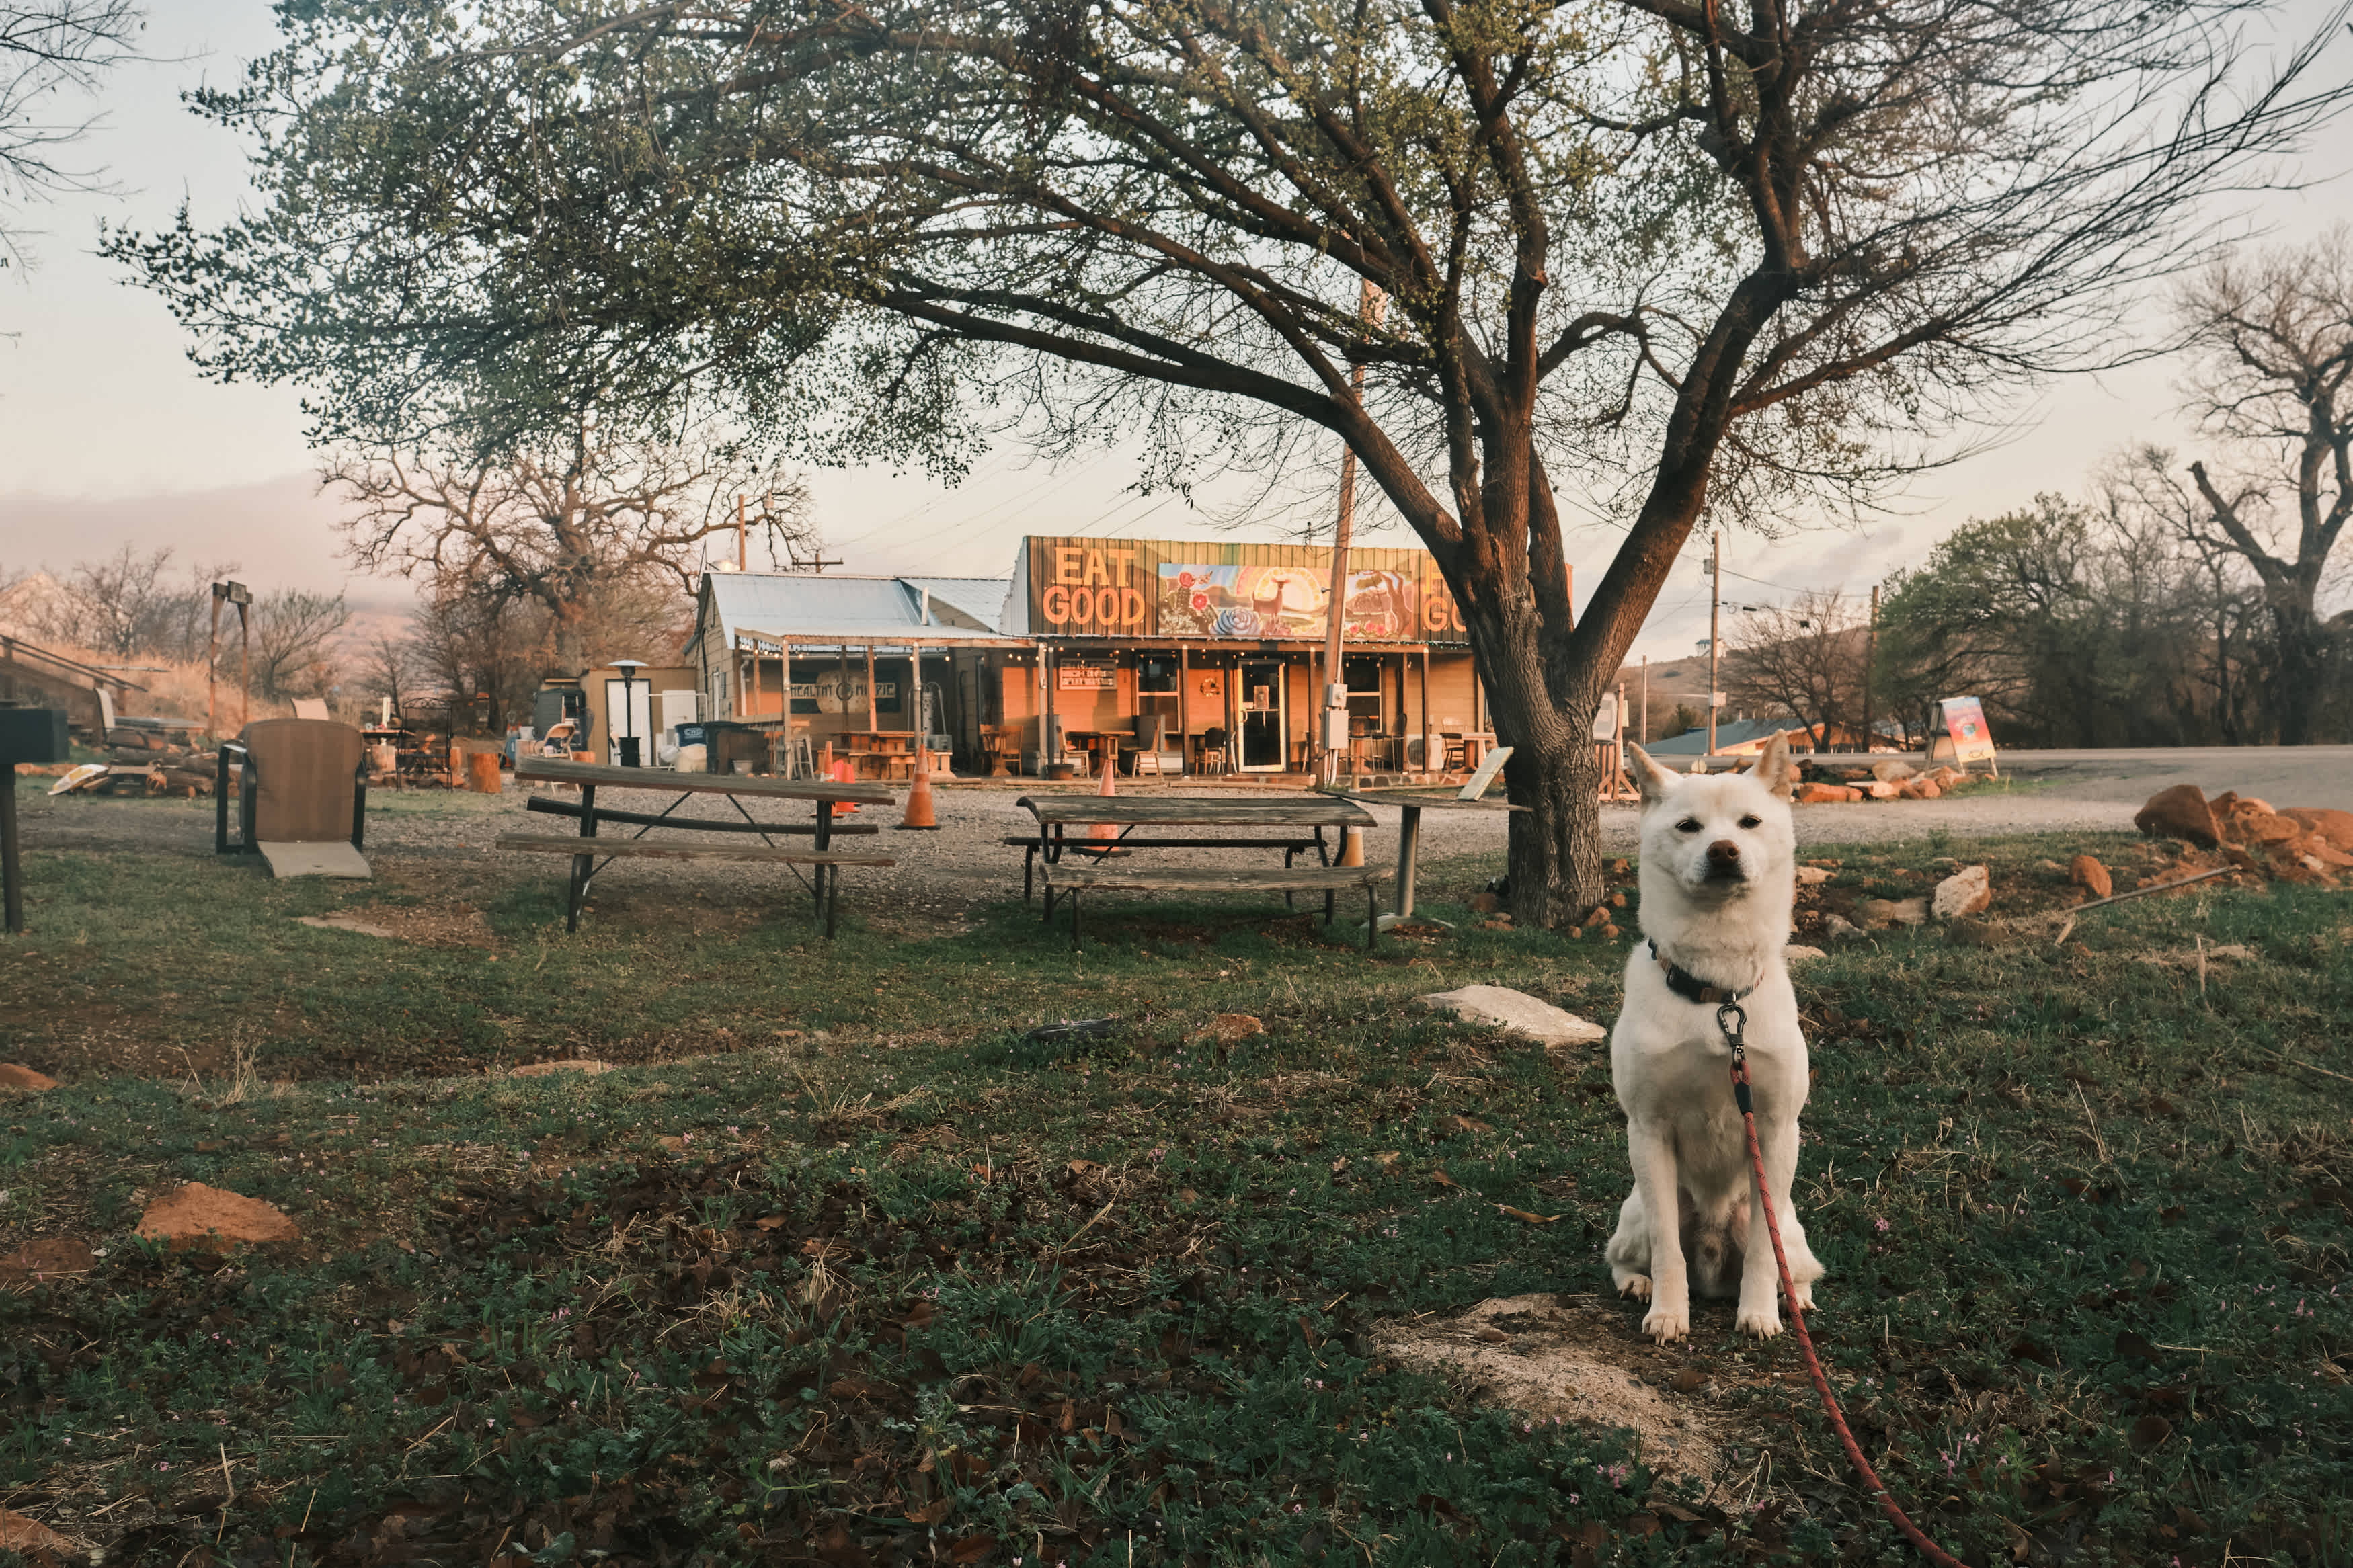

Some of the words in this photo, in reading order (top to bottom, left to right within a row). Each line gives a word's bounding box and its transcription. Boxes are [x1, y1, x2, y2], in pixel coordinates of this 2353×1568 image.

[1055, 546, 1135, 587] EAT
[1043, 585, 1146, 626] GOOD
[790, 684, 833, 697] HEALTHY
[856, 684, 893, 696] HIPIE
